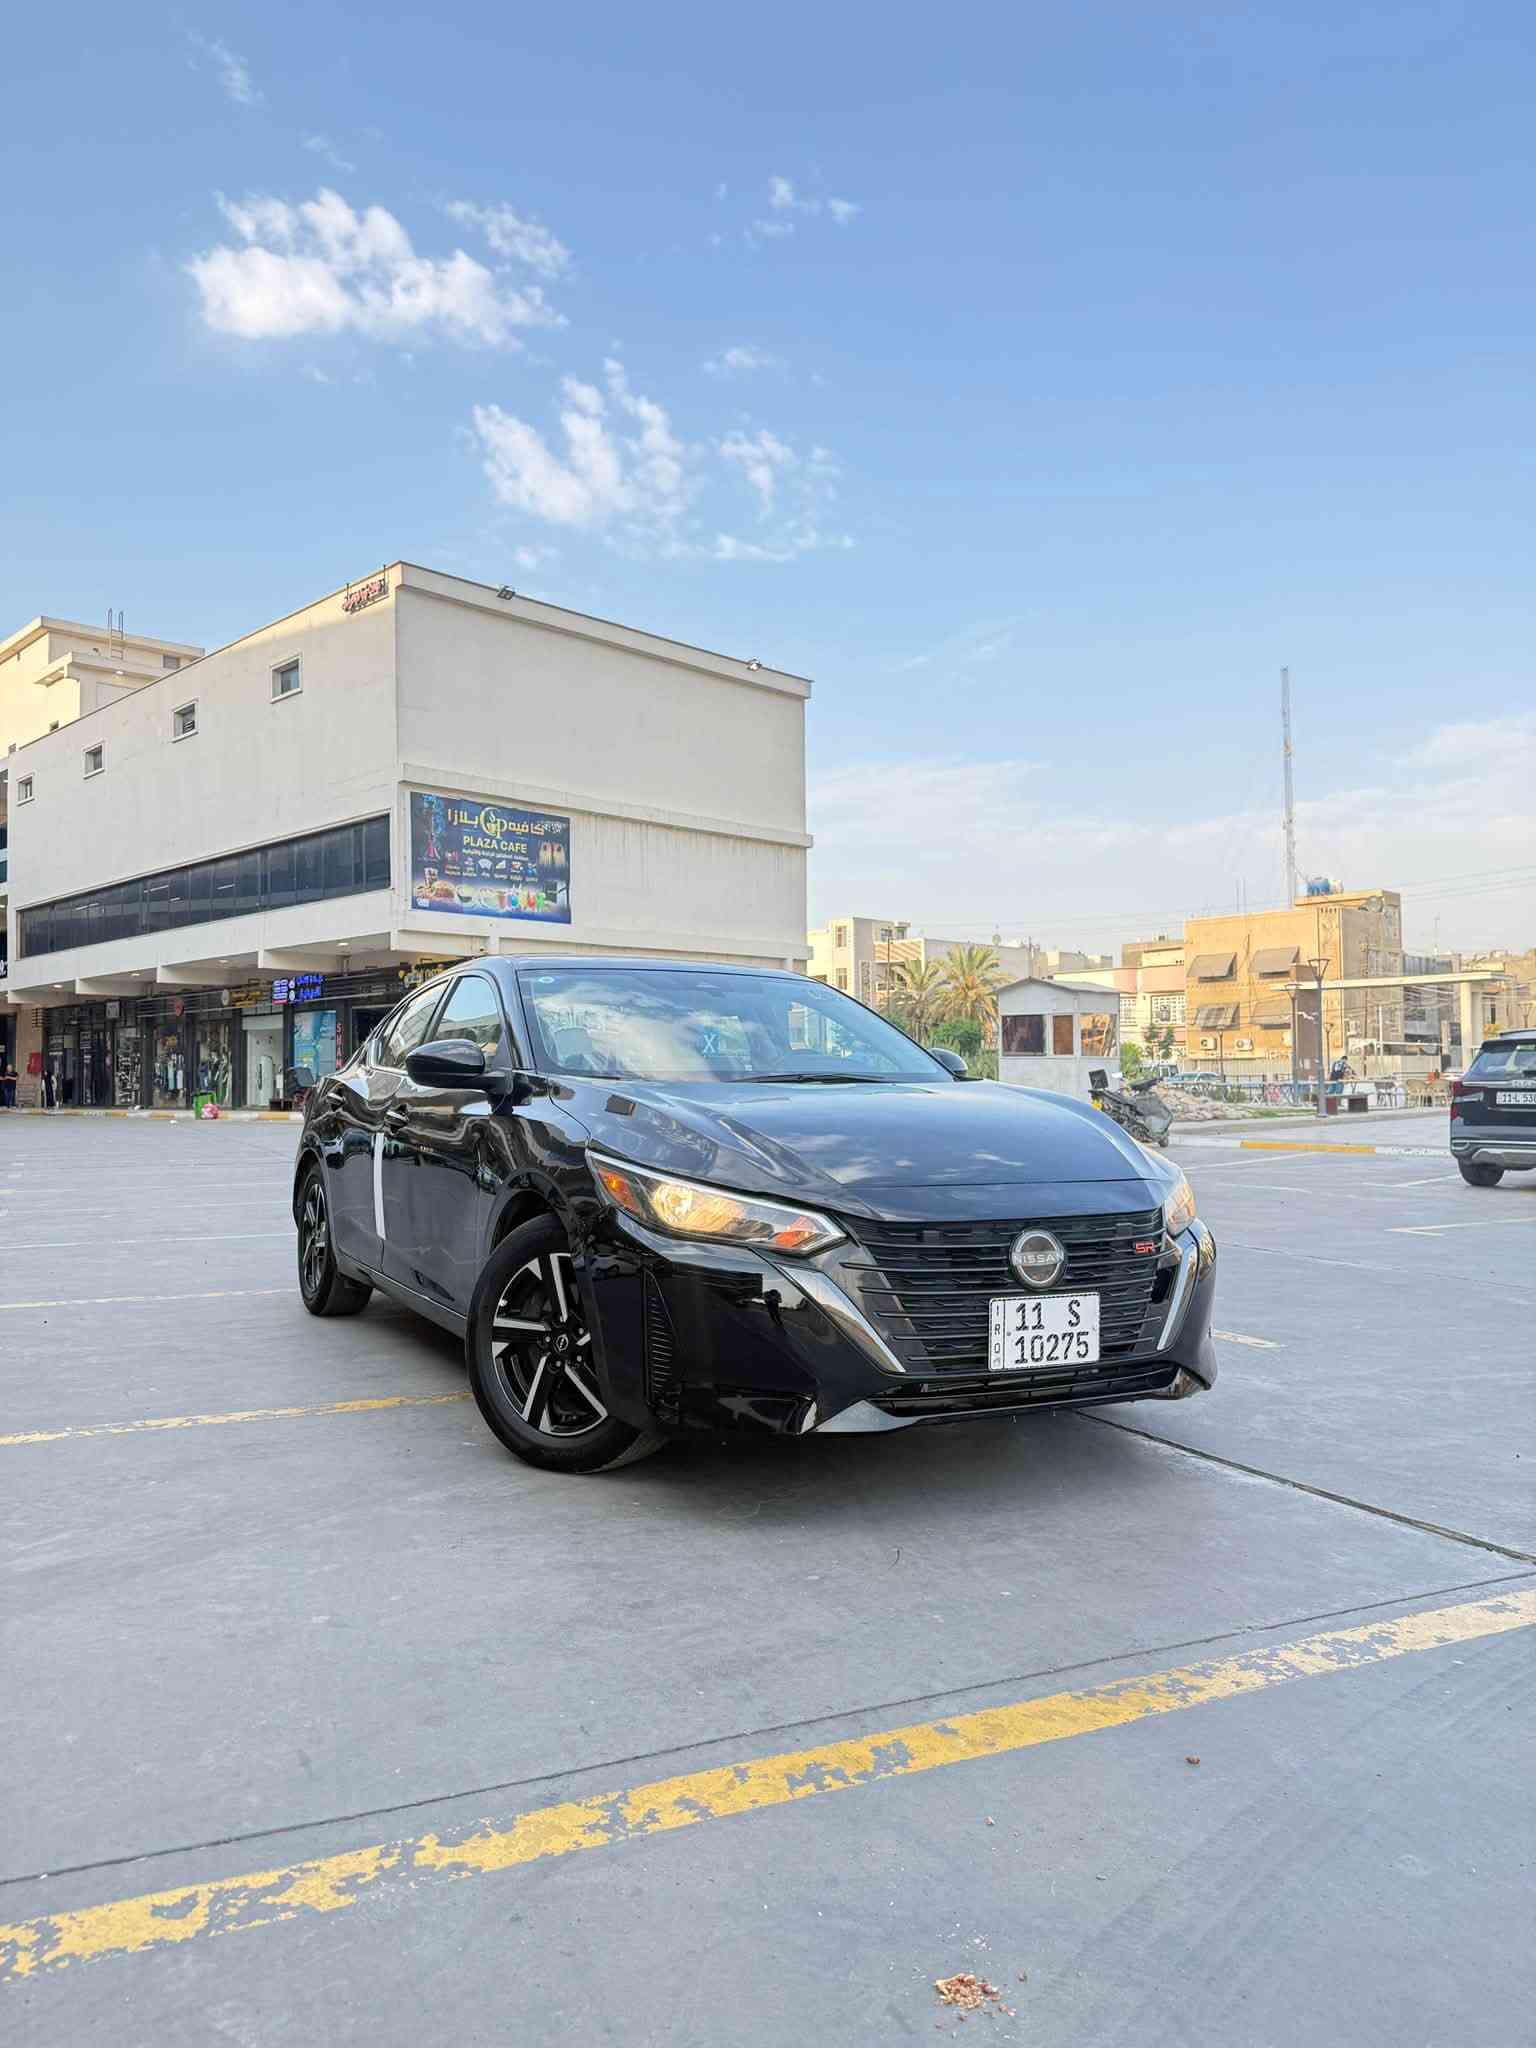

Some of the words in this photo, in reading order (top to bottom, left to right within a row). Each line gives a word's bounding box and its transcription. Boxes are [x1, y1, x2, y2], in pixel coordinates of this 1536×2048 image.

[447, 808, 479, 828] بلازا
[463, 835, 498, 850] PLAZA
[500, 840, 528, 854] CAFE
[1135, 1242, 1155, 1254] SR
[1015, 1302, 1045, 1331] 11
[1067, 1299, 1081, 1328] S
[1014, 1331, 1090, 1364] 10275
